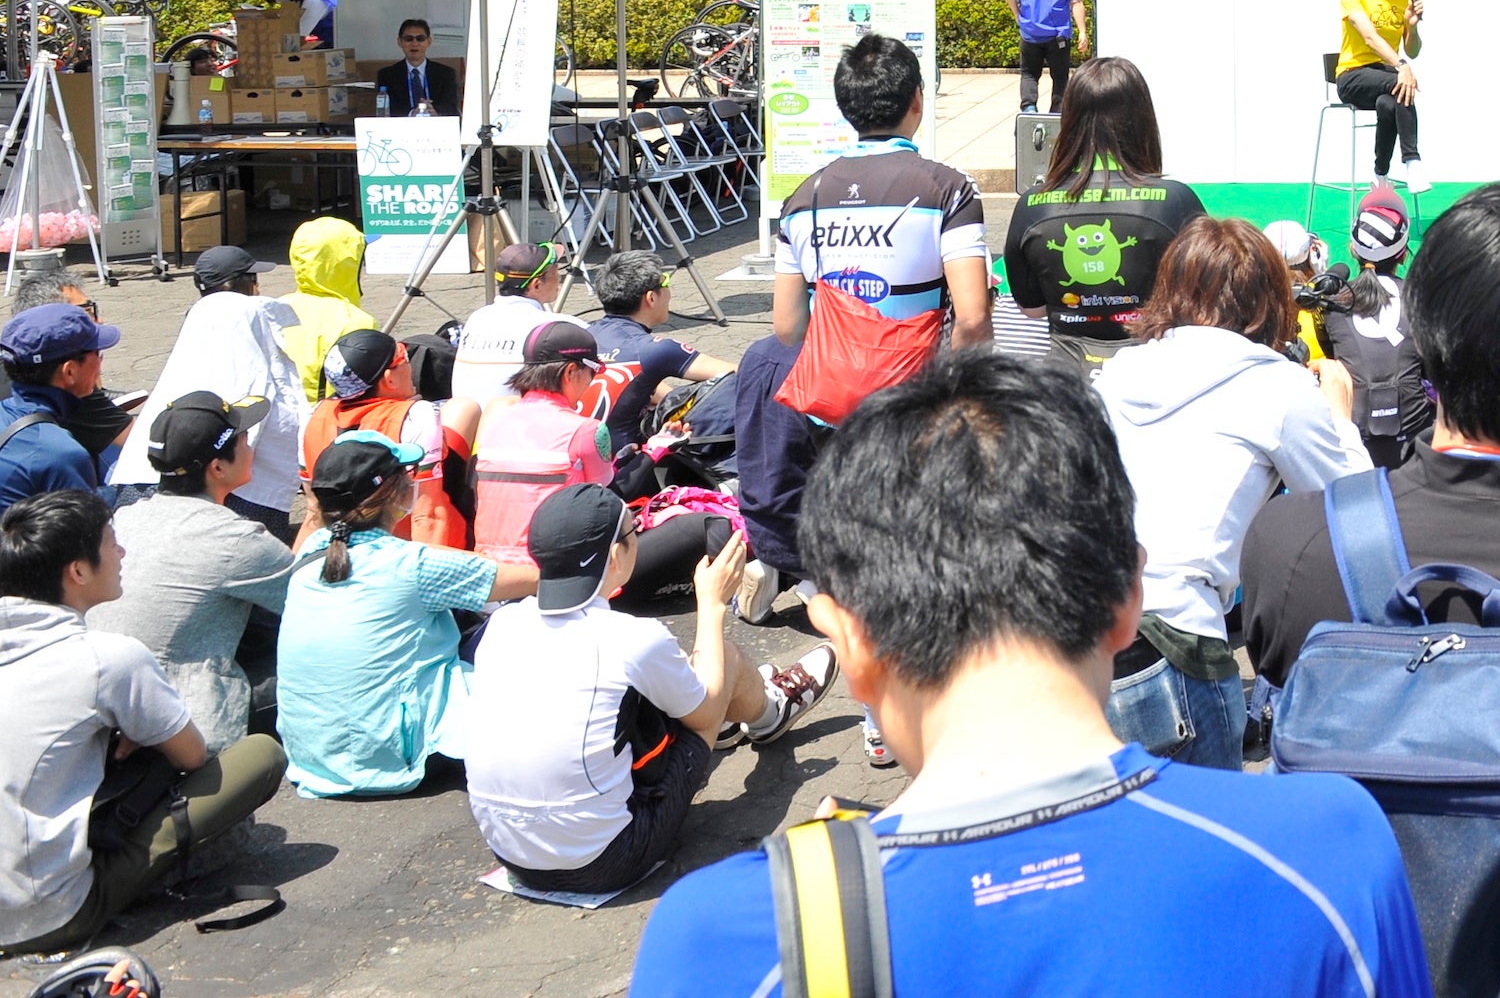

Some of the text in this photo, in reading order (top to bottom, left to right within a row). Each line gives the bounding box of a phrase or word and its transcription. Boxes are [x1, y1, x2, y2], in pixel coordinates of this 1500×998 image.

[366, 184, 459, 202] SHARE
[366, 202, 460, 215] THE ROAD
[1081, 261, 1105, 274] 158
[858, 279, 885, 299] STEP
[959, 812, 1034, 841] ARMOUR
[1053, 785, 1124, 816] ARMOUR
